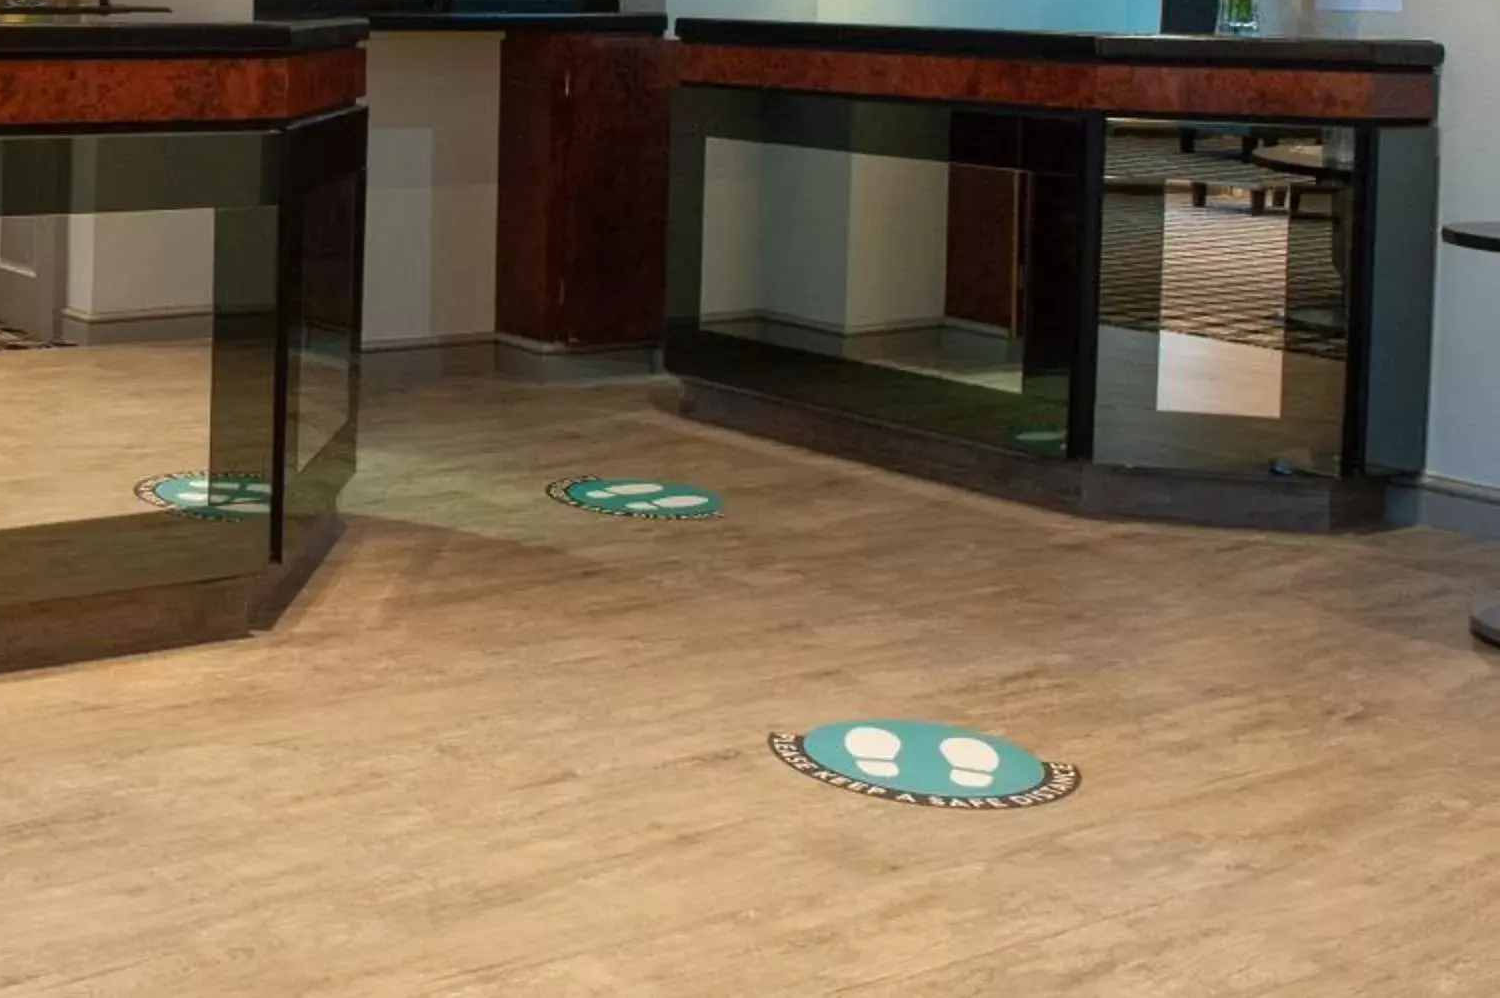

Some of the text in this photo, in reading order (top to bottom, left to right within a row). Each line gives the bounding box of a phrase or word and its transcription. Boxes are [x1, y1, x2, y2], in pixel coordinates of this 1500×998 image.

[773, 733, 1076, 809] PLEASE KEEP A SAFE DISTANCE
